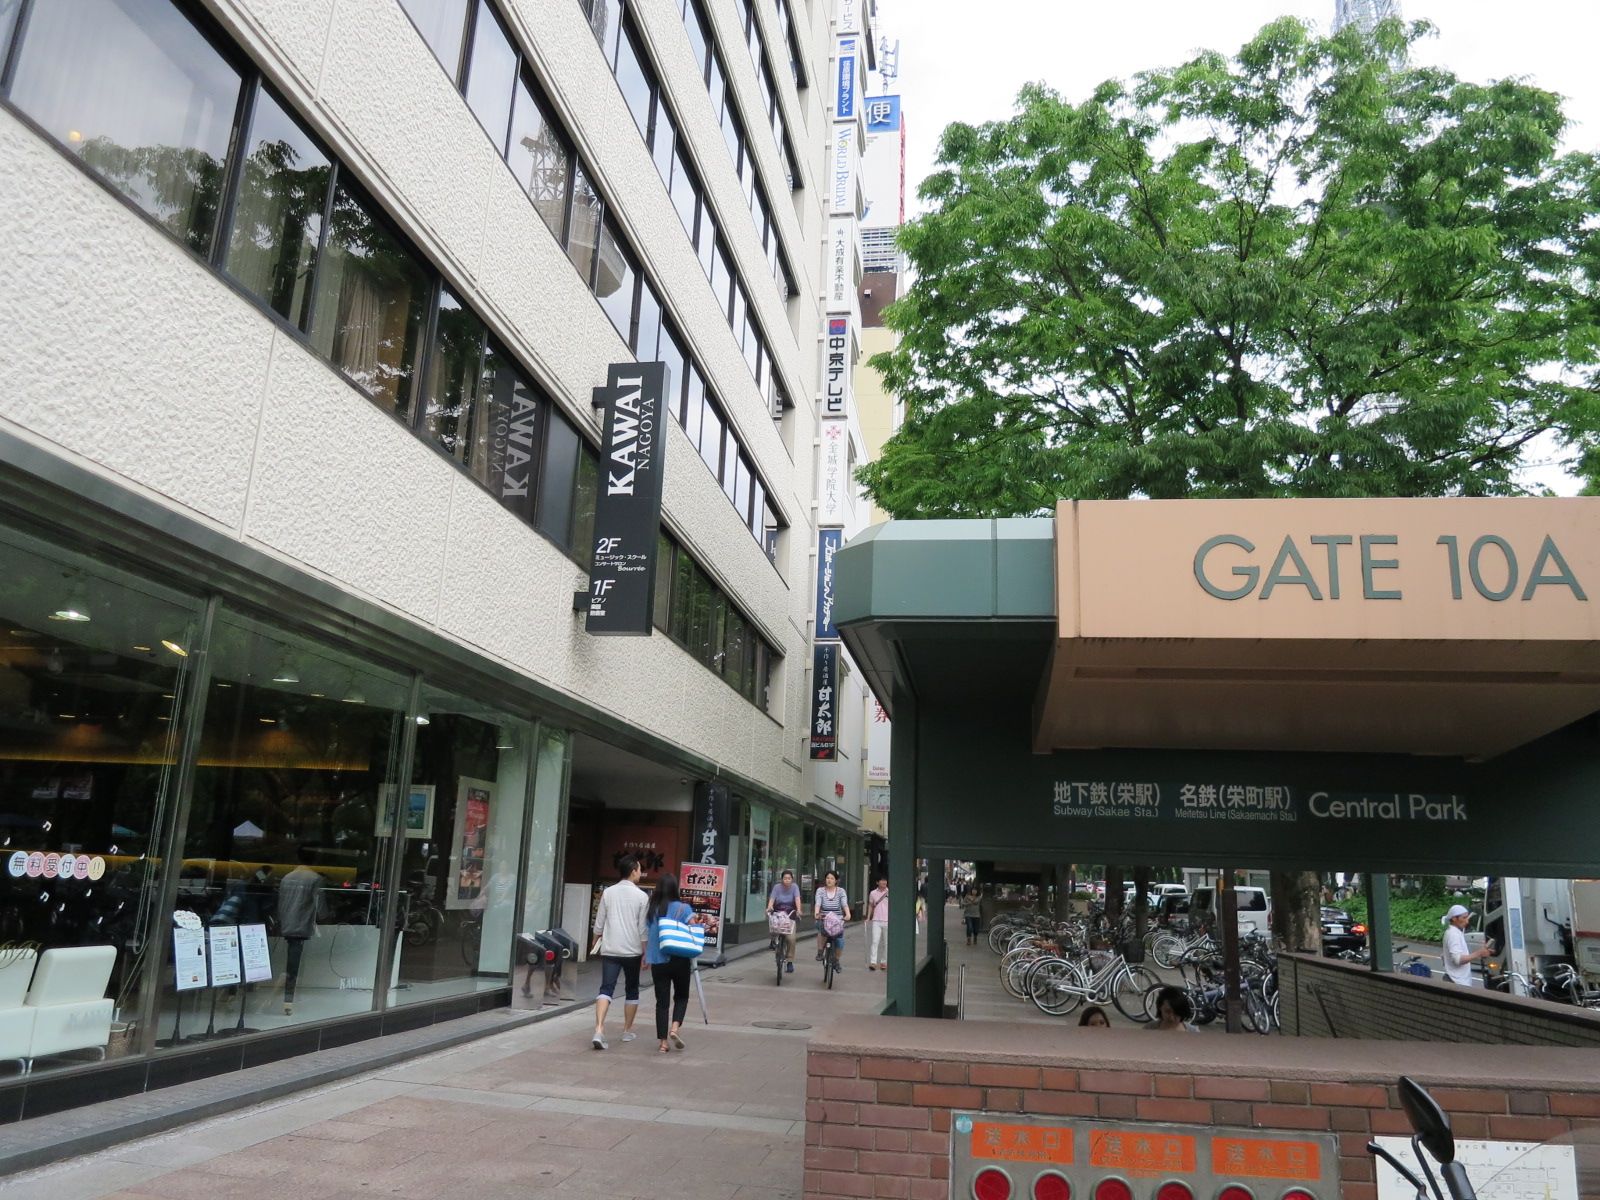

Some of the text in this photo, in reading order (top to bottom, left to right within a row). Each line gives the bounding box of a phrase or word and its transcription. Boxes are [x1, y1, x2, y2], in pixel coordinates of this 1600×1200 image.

[867, 101, 891, 124] 便
[835, 127, 852, 210] WORLD BRIDAL
[827, 336, 845, 412] 中京テレビ
[607, 375, 643, 496] KAWAI
[636, 397, 655, 470] NAGOYA
[825, 441, 841, 516] 金城学院大学
[595, 537, 622, 554] 2F
[1193, 533, 1588, 601] GATE 10A
[593, 579, 616, 596] 1F
[815, 686, 833, 736] 甘太郎
[1053, 781, 1292, 810] 地下鉄(栄駅) 名鉄(栄町駅)
[1308, 791, 1468, 821] Central Park
[1054, 805, 1159, 817] Subway (Sakae Sta.)
[1175, 807, 1208, 819] Meitetsu
[1209, 809, 1227, 819] Line
[1227, 809, 1278, 821] (Sakaemachi
[686, 873, 718, 887] 甘太郎
[1105, 1135, 1183, 1156] 送水口
[1226, 1144, 1306, 1165] 送水口
